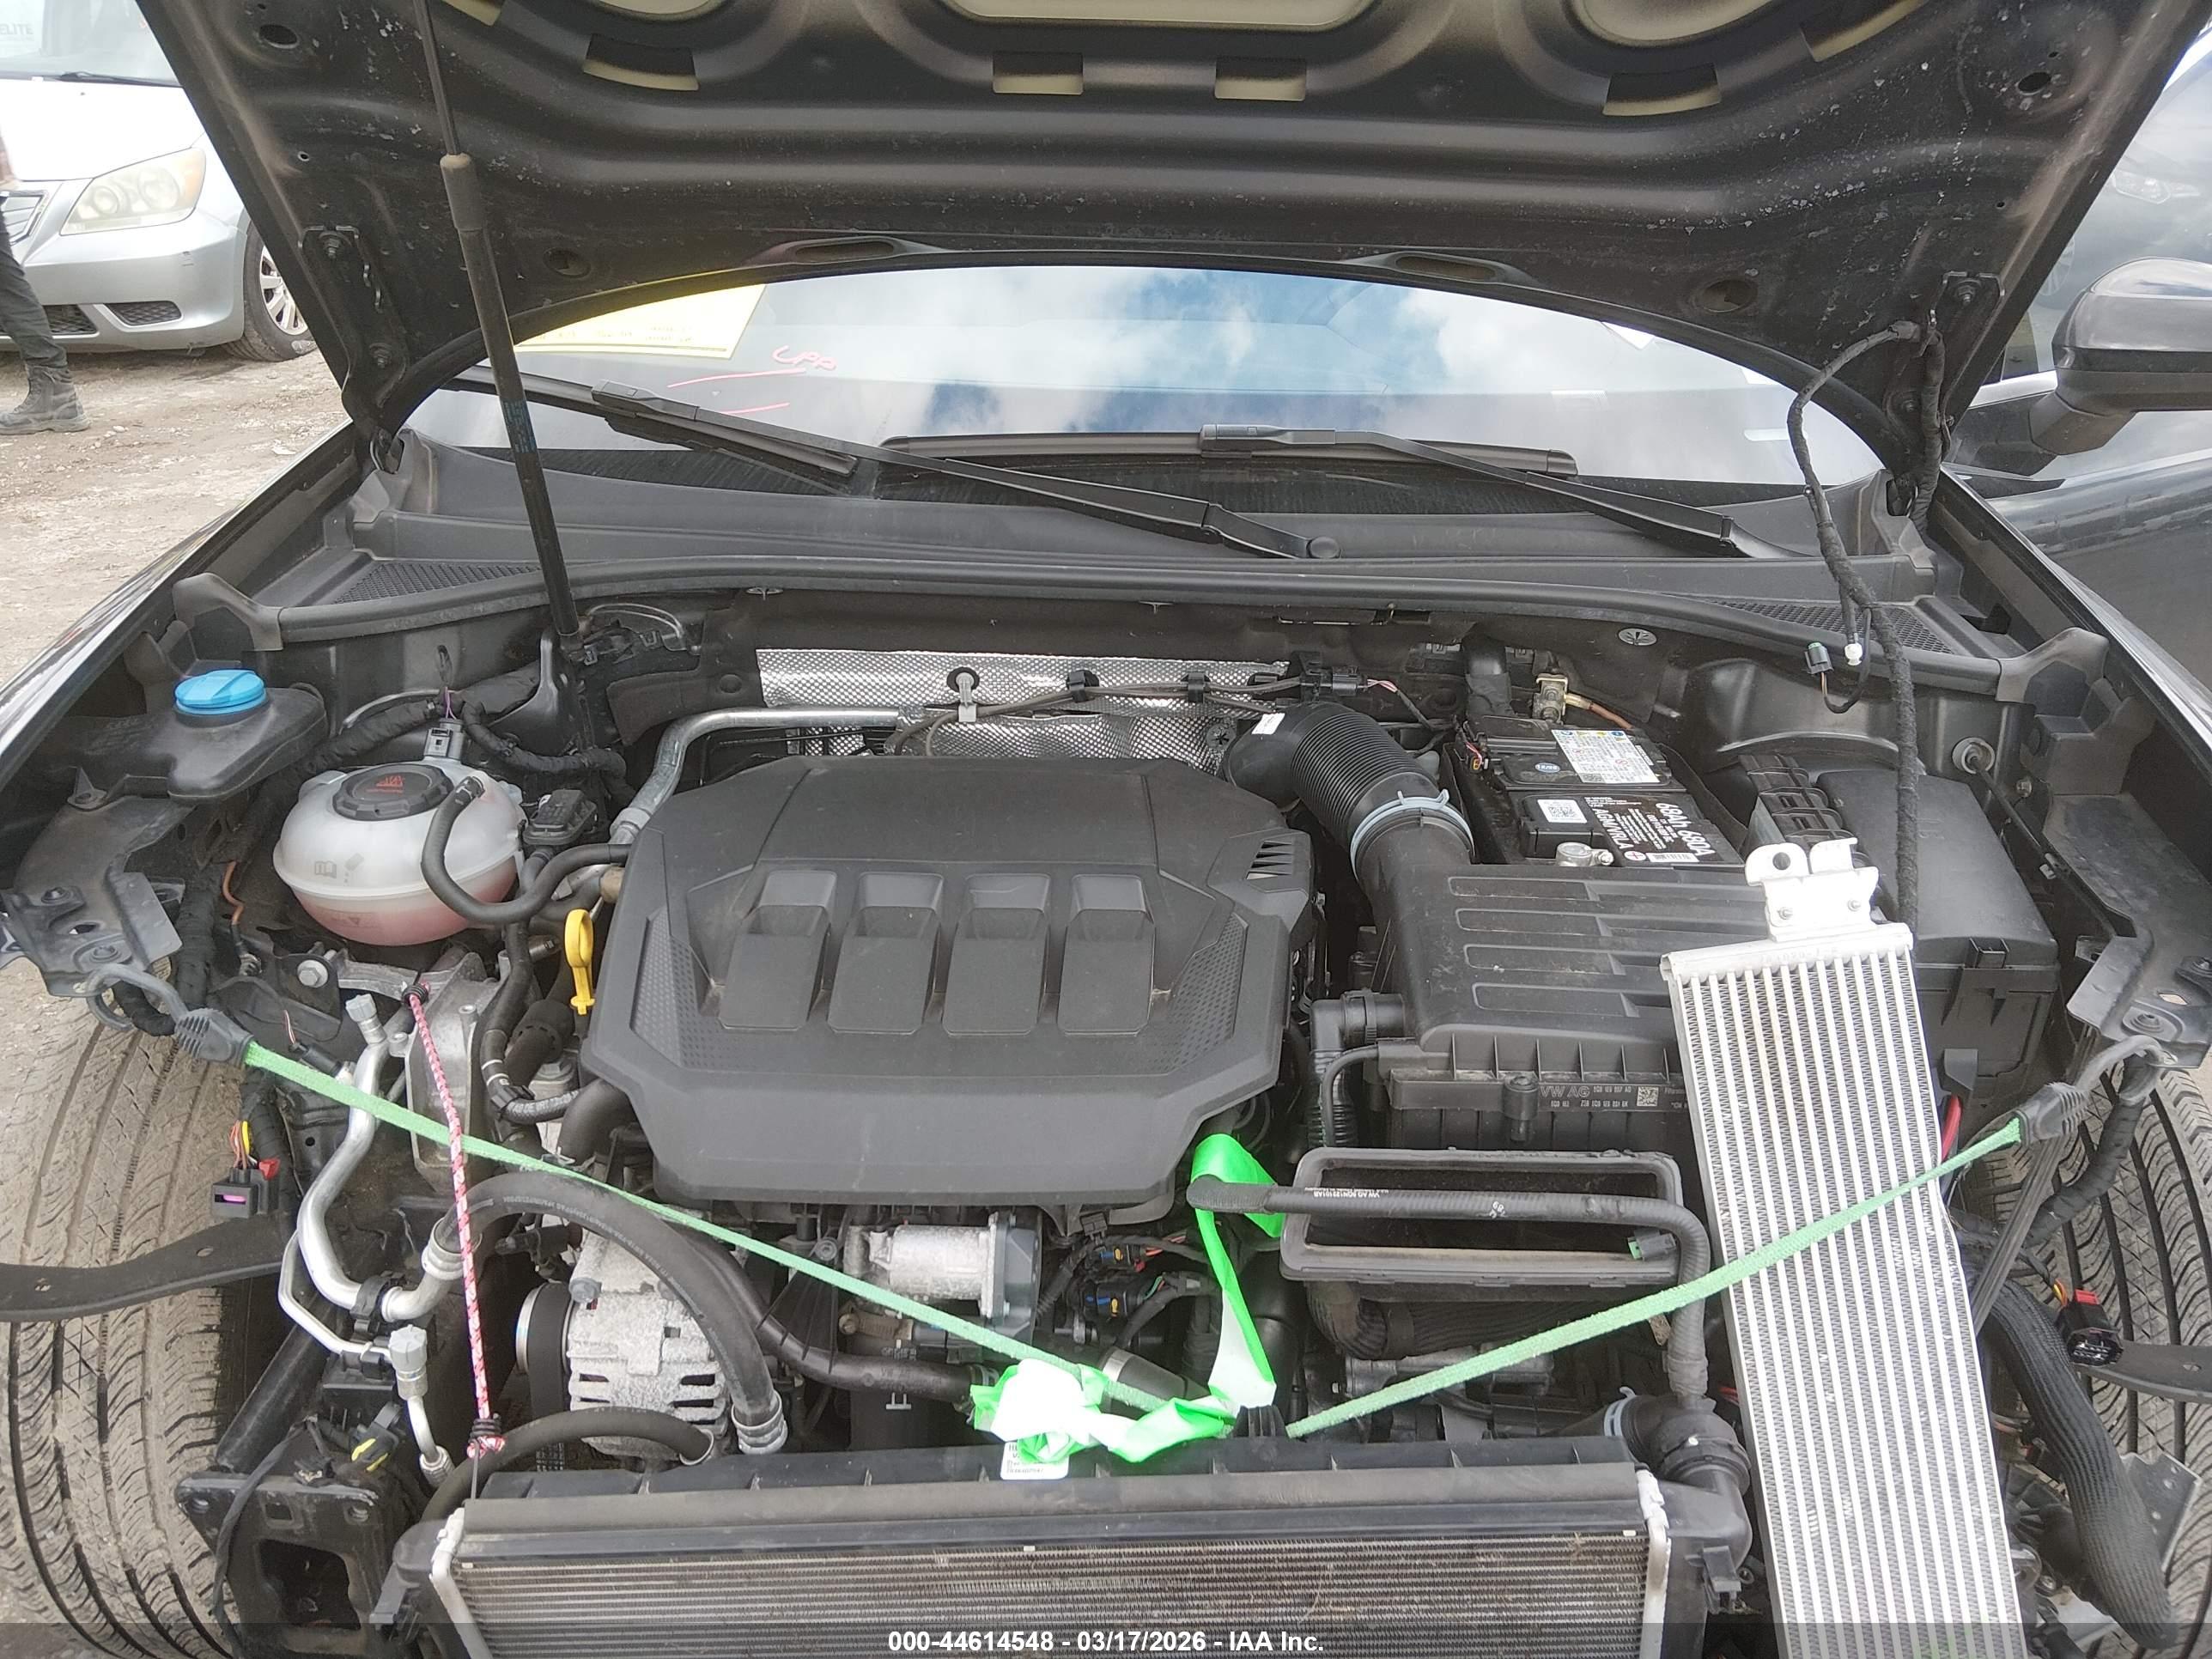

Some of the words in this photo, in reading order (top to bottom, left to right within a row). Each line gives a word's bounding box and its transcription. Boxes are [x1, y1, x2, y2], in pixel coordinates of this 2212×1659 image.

[1656, 803, 1692, 827] 68Ah
[1677, 830, 1716, 856] 680A
[1540, 1085, 1565, 1097] VW
[1566, 1085, 1590, 1097] AG
